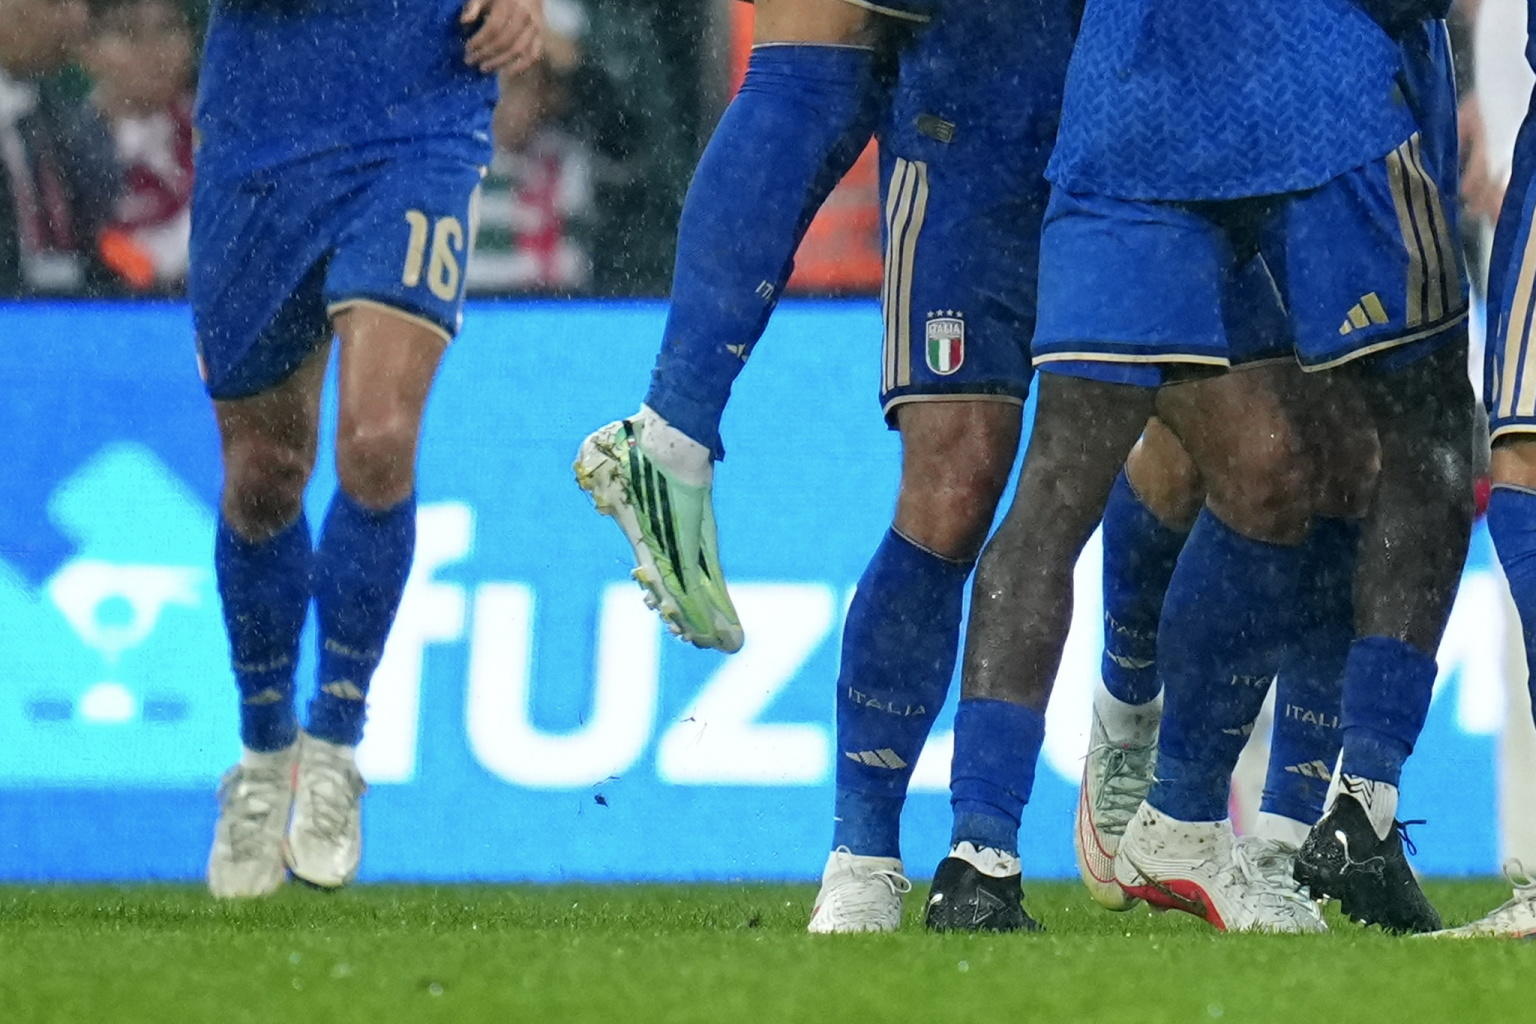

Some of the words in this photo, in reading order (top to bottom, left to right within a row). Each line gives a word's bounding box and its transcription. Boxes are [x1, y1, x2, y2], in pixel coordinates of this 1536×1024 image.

[402, 208, 464, 302] 16
[848, 686, 926, 717] ITALIA
[1285, 703, 1344, 729] ITALI
